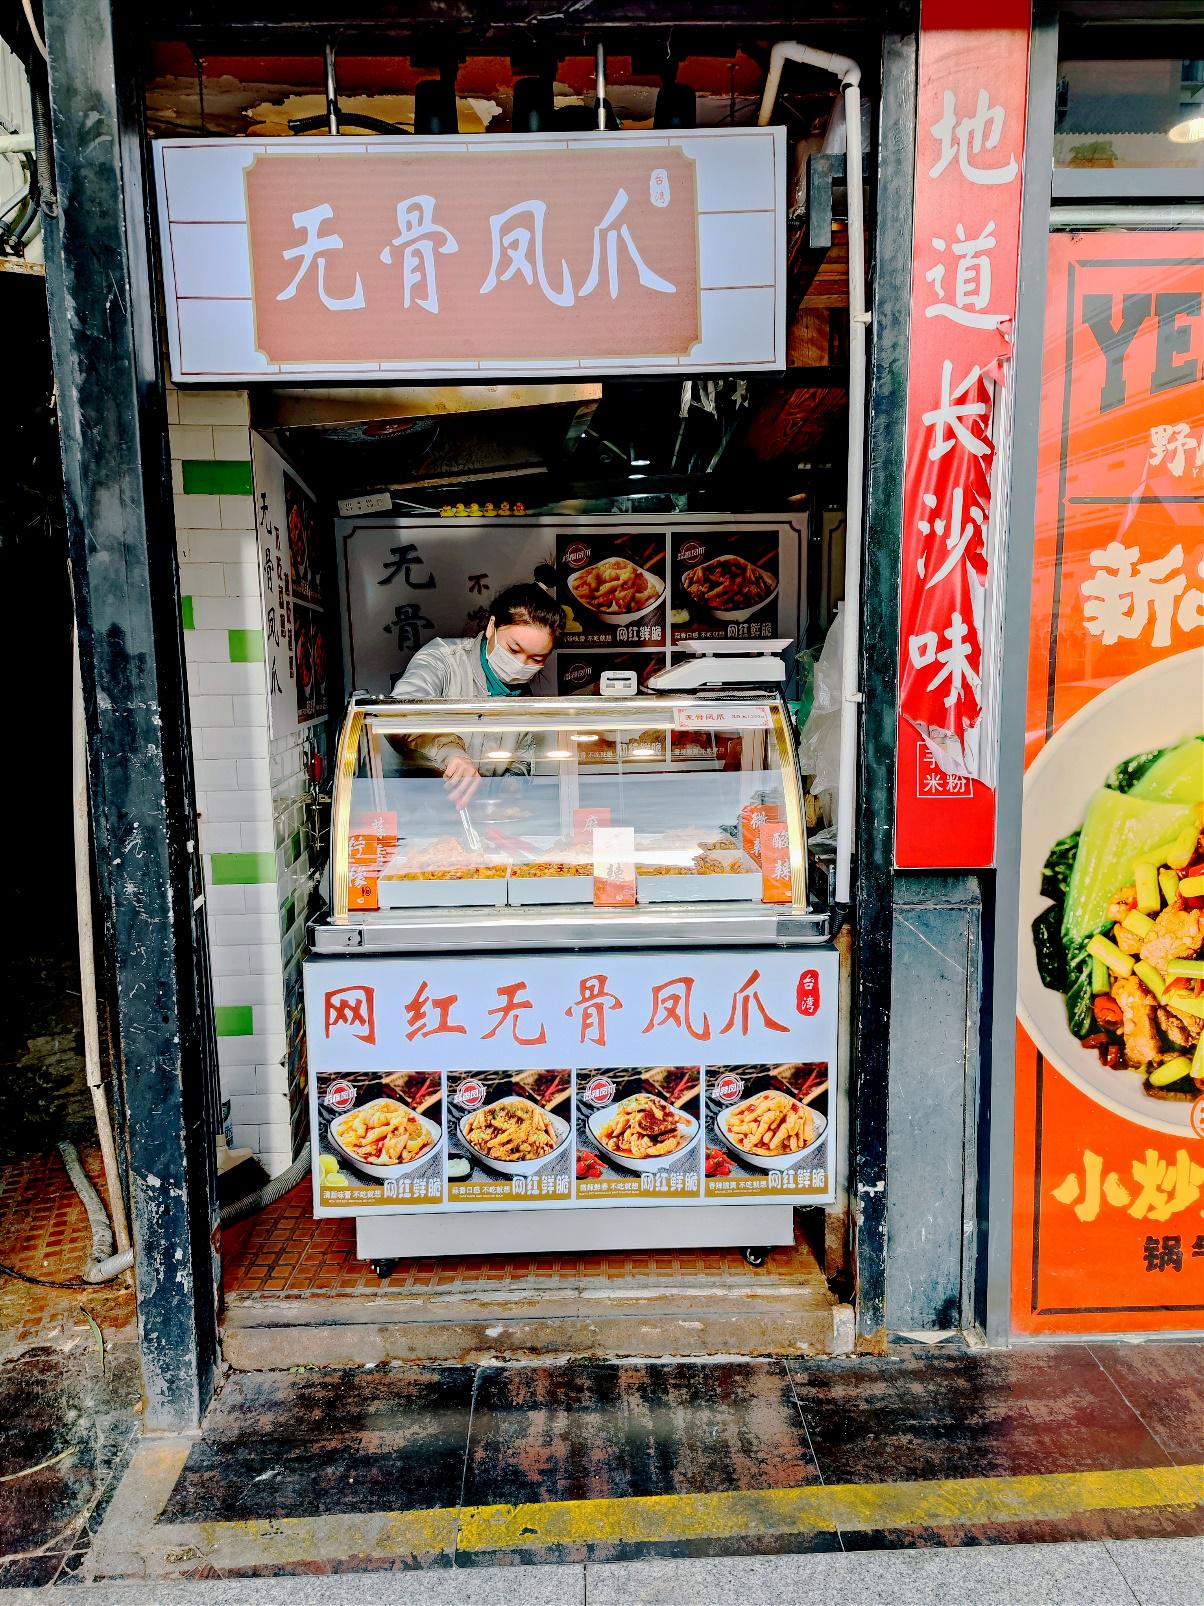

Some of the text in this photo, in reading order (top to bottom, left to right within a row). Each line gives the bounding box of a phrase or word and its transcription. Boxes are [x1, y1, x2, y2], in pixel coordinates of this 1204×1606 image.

[276, 187, 677, 315] 无骨凤爪
[907, 88, 1019, 709] 地道长沙味
[1148, 422, 1204, 478] 野
[616, 625, 663, 642] 网红鲜脆
[923, 773, 967, 793] 米粉
[323, 968, 791, 1047] 网红无骨凤爪
[801, 973, 815, 1013] 台湾
[383, 1178, 442, 1199] 网红鲜脆
[511, 1174, 570, 1195] 网红鲜脆
[640, 1172, 699, 1192] 网红鲜脆
[768, 1168, 826, 1189] 网红鲜脆
[1050, 1148, 1204, 1223] 小炒
